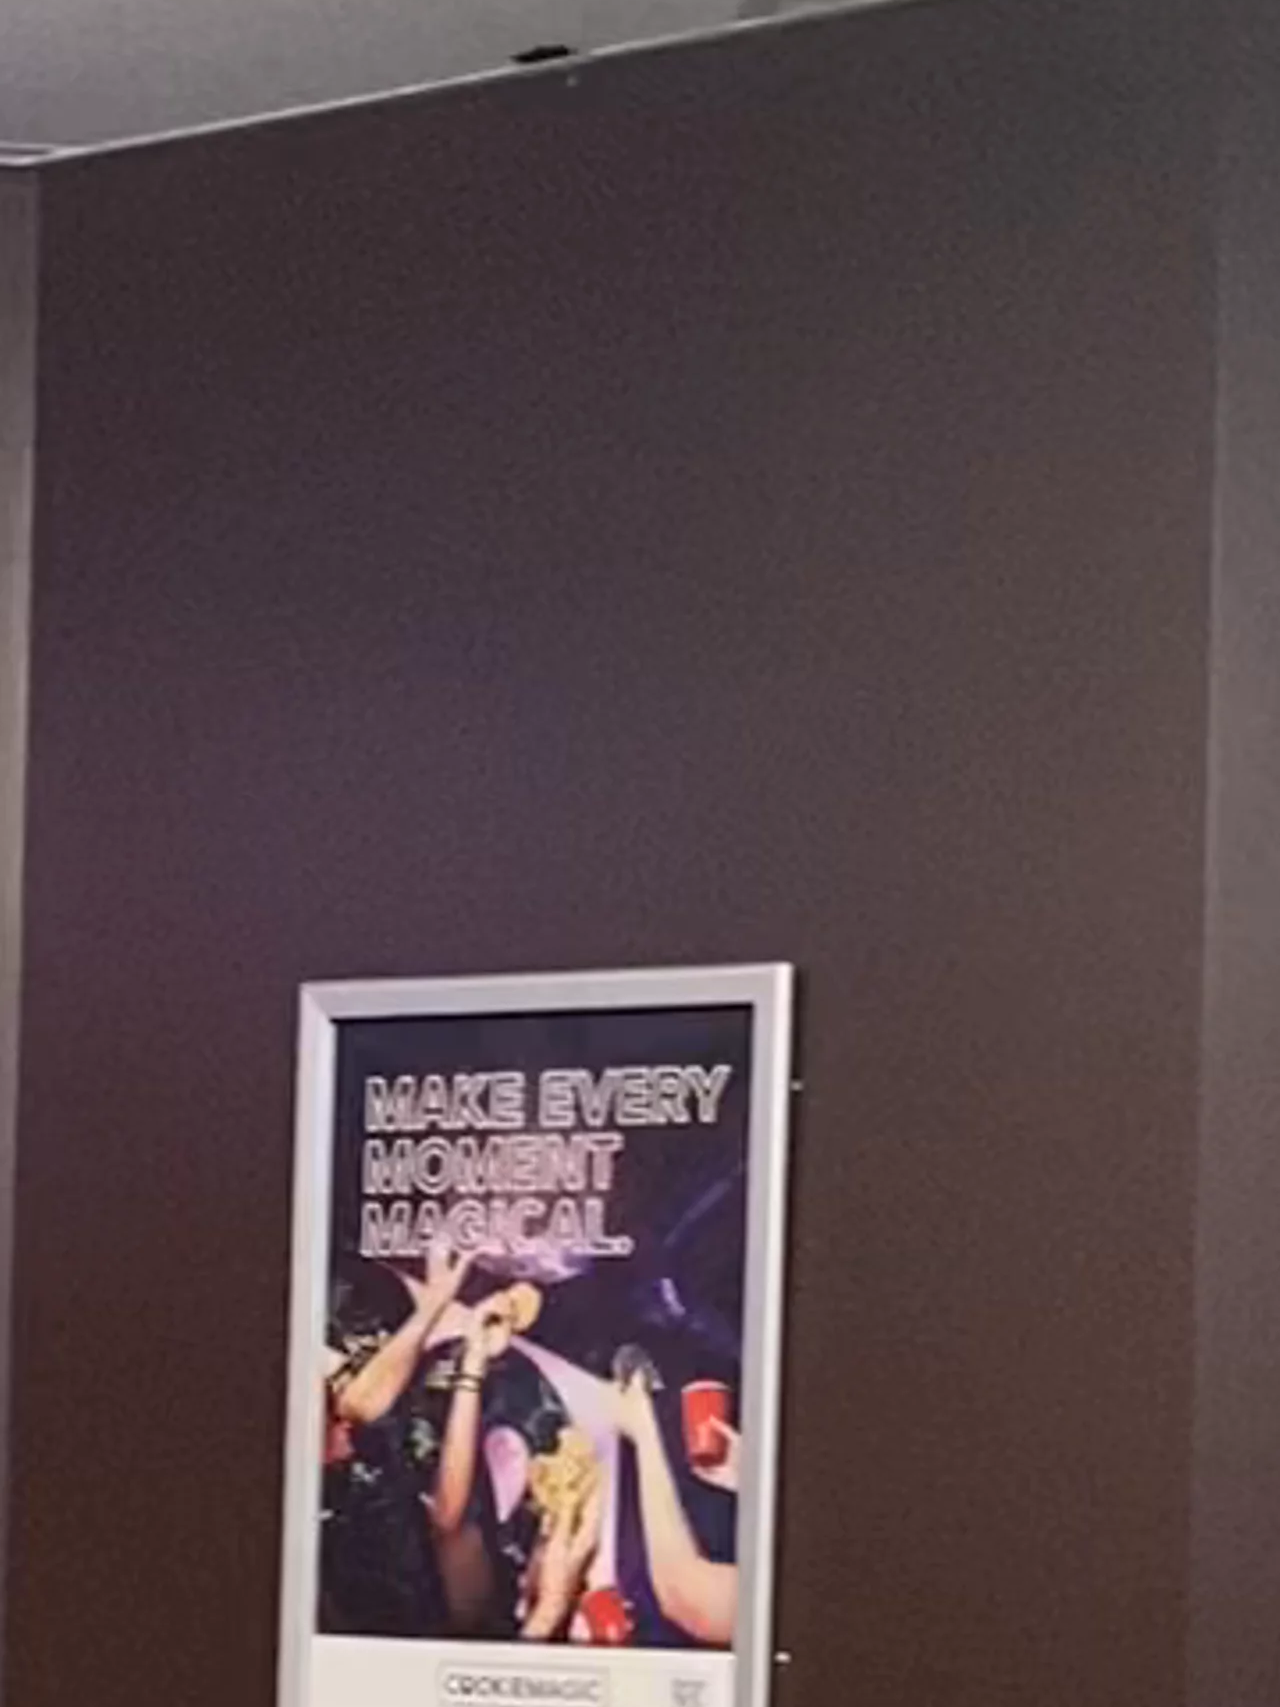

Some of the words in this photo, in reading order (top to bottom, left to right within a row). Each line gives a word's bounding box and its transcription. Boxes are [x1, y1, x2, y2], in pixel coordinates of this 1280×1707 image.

[365, 1072, 525, 1131] MAKE
[538, 1065, 732, 1128] EVERY
[363, 1134, 625, 1194] MOMENT
[359, 1198, 636, 1257] MAGICAL.
